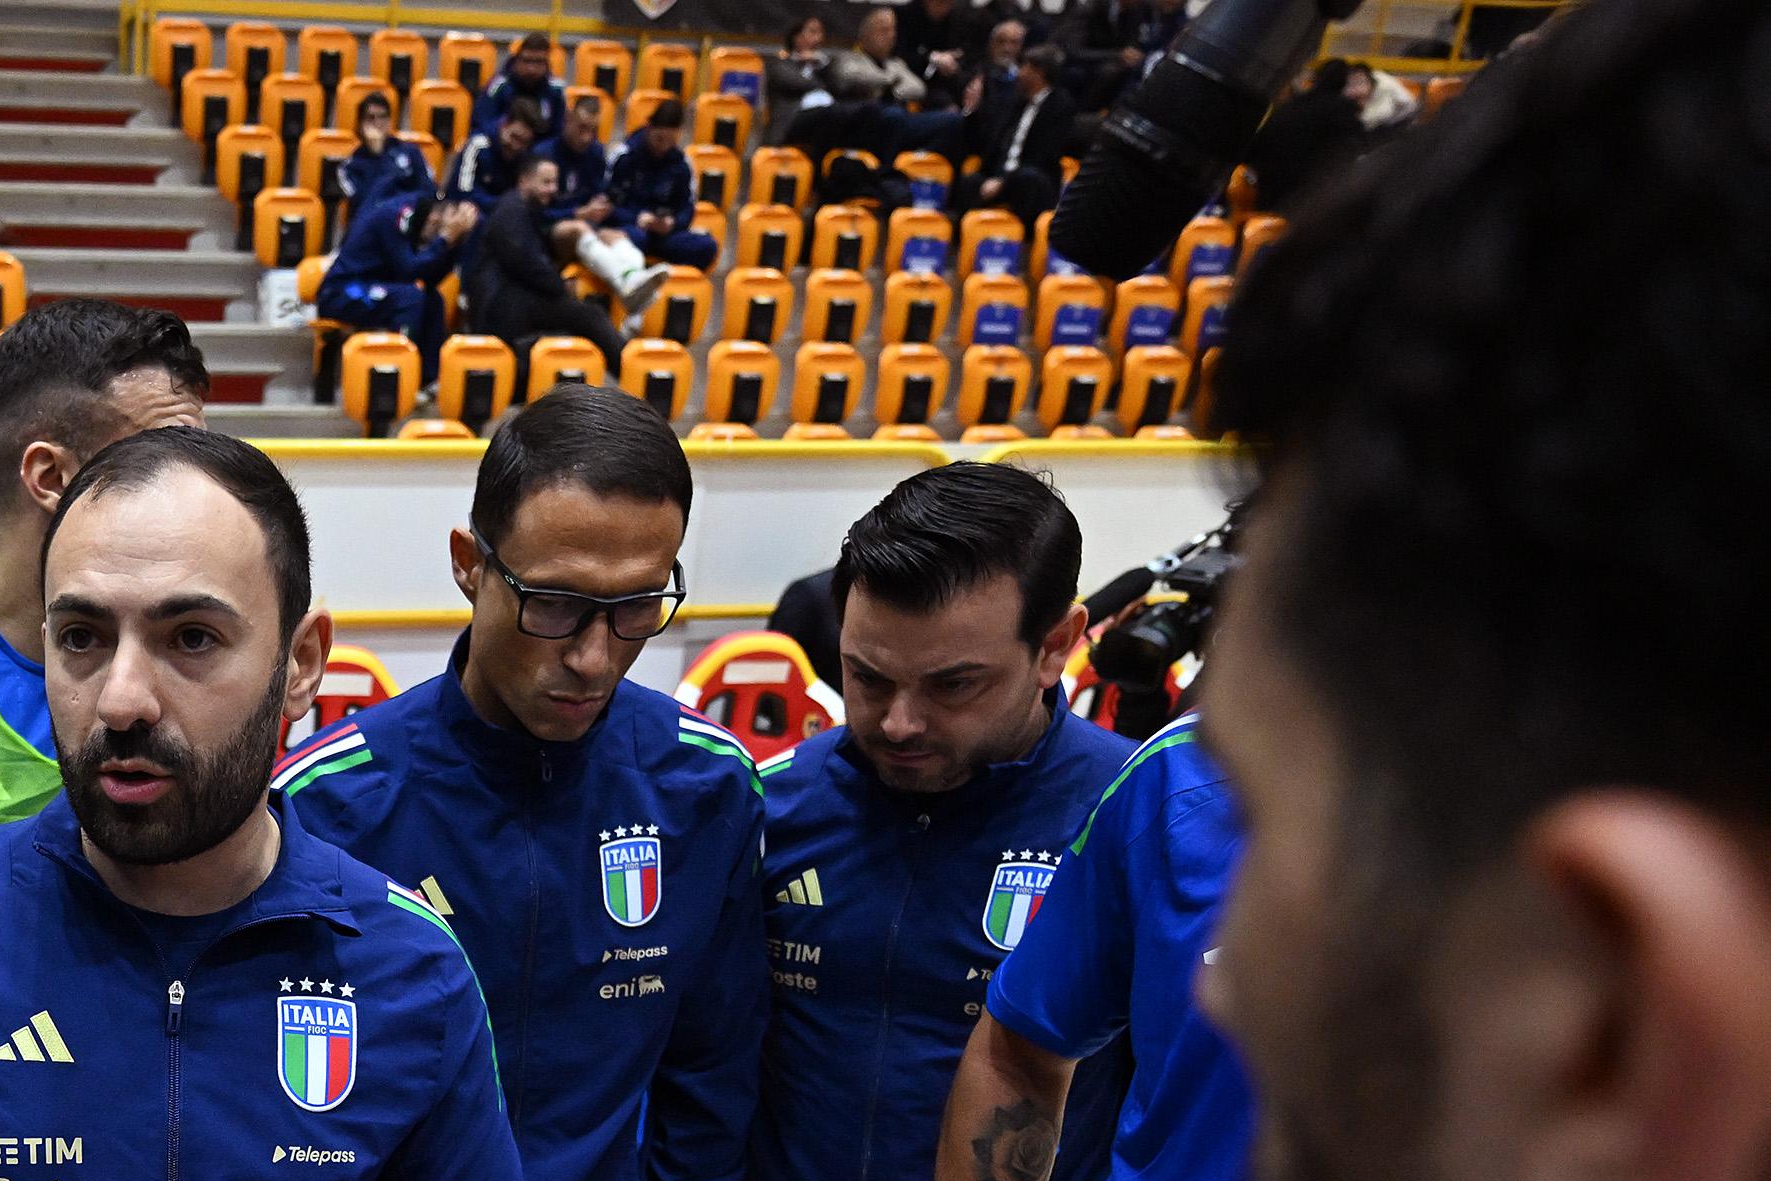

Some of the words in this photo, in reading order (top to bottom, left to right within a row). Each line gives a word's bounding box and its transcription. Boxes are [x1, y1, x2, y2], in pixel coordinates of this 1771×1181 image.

[605, 844, 656, 866] ITALIA
[997, 870, 1055, 889] ITALIA
[613, 945, 668, 961] Telepass
[783, 941, 821, 965] TIM
[599, 978, 637, 999] eni
[772, 971, 817, 990] oste
[282, 1003, 350, 1028] ITALIA
[307, 1025, 327, 1035] FIGC
[23, 1137, 83, 1165] TIM
[288, 1145, 356, 1167] Telepass
